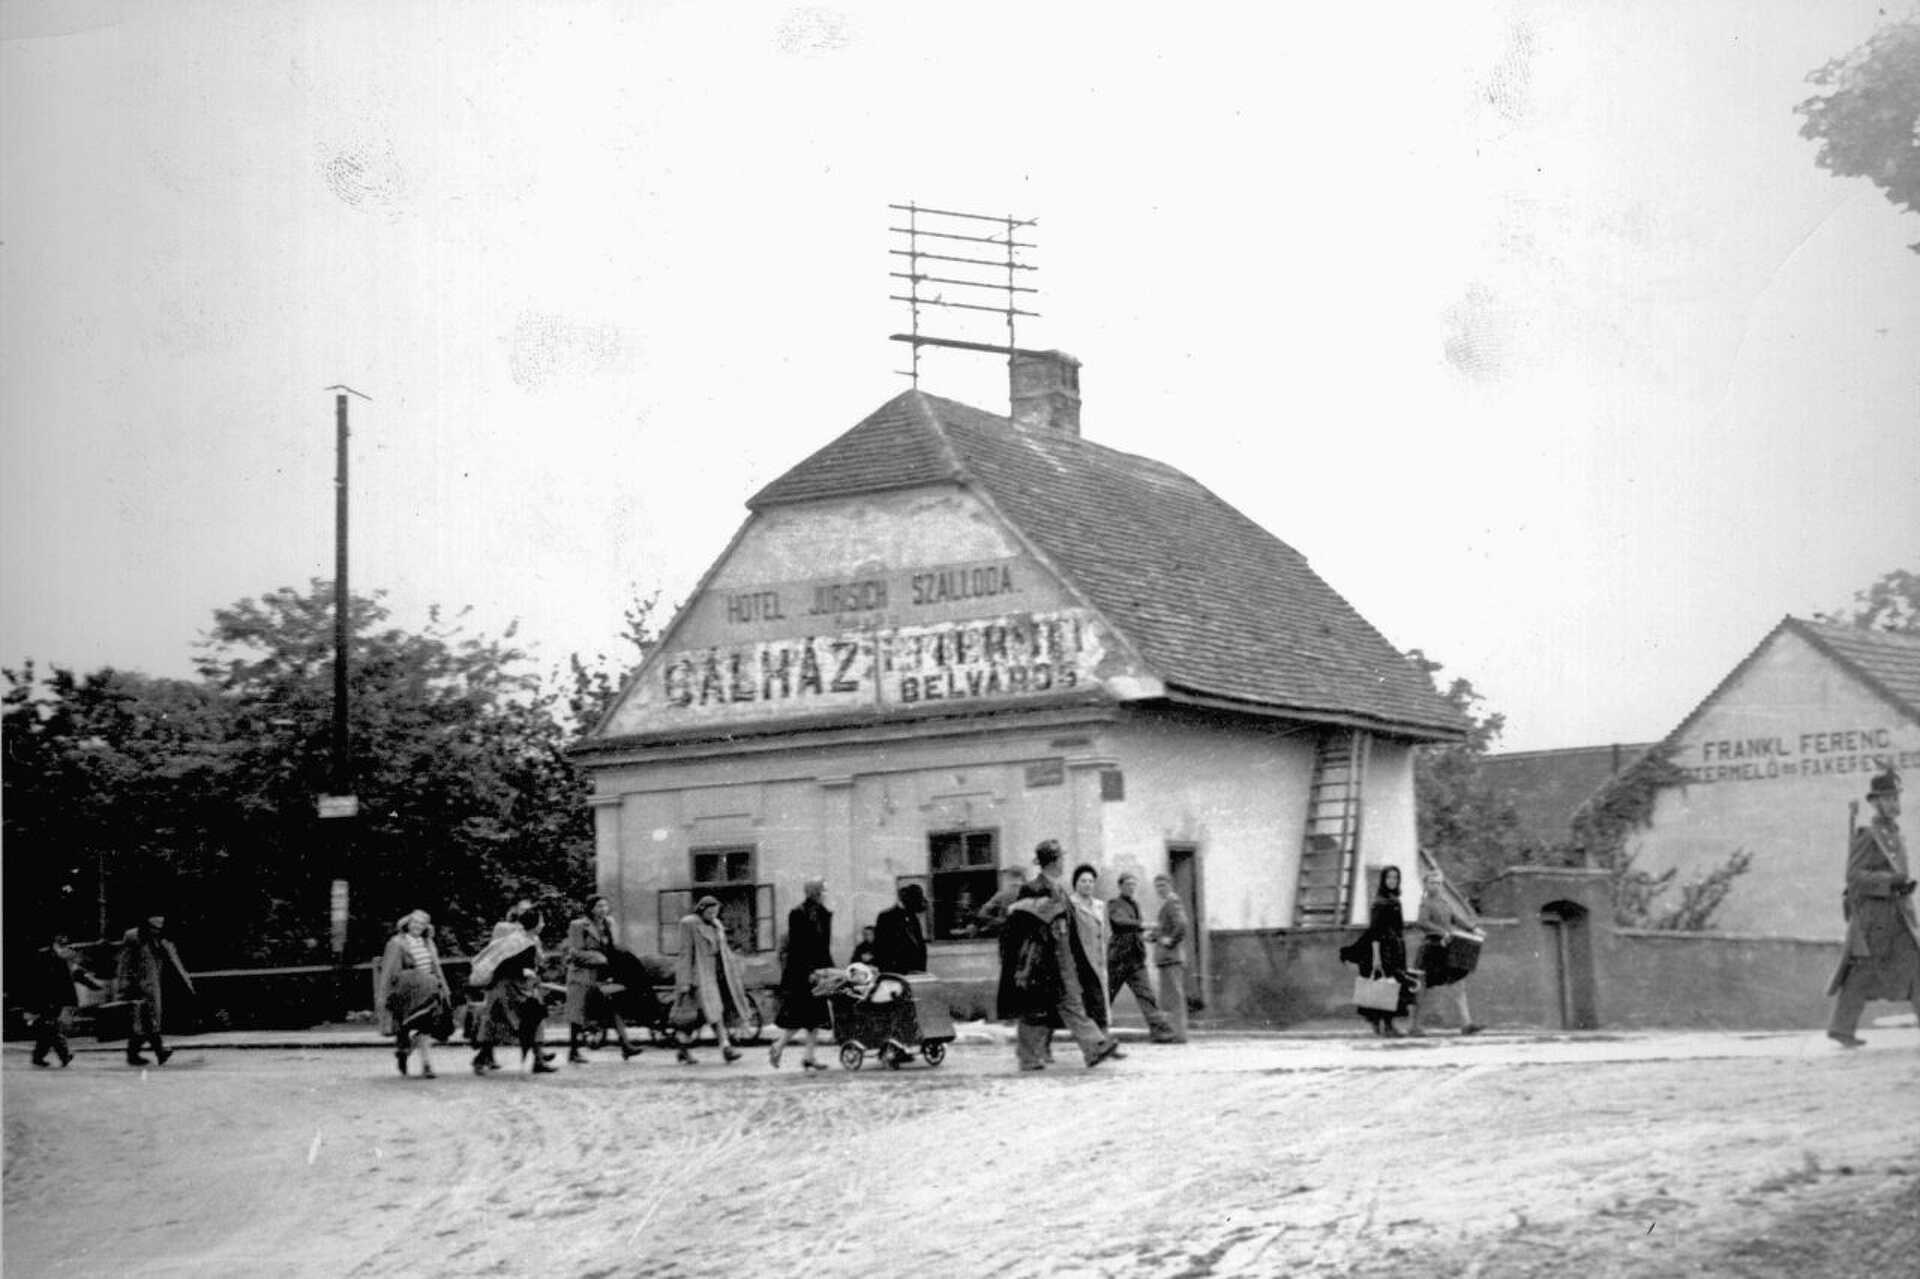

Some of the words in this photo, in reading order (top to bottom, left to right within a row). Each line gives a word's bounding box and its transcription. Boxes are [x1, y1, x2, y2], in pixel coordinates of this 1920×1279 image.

[728, 591, 786, 625] HOTEL
[1703, 737, 1791, 761] FRANKL
[1800, 729, 1889, 754] FERENC
